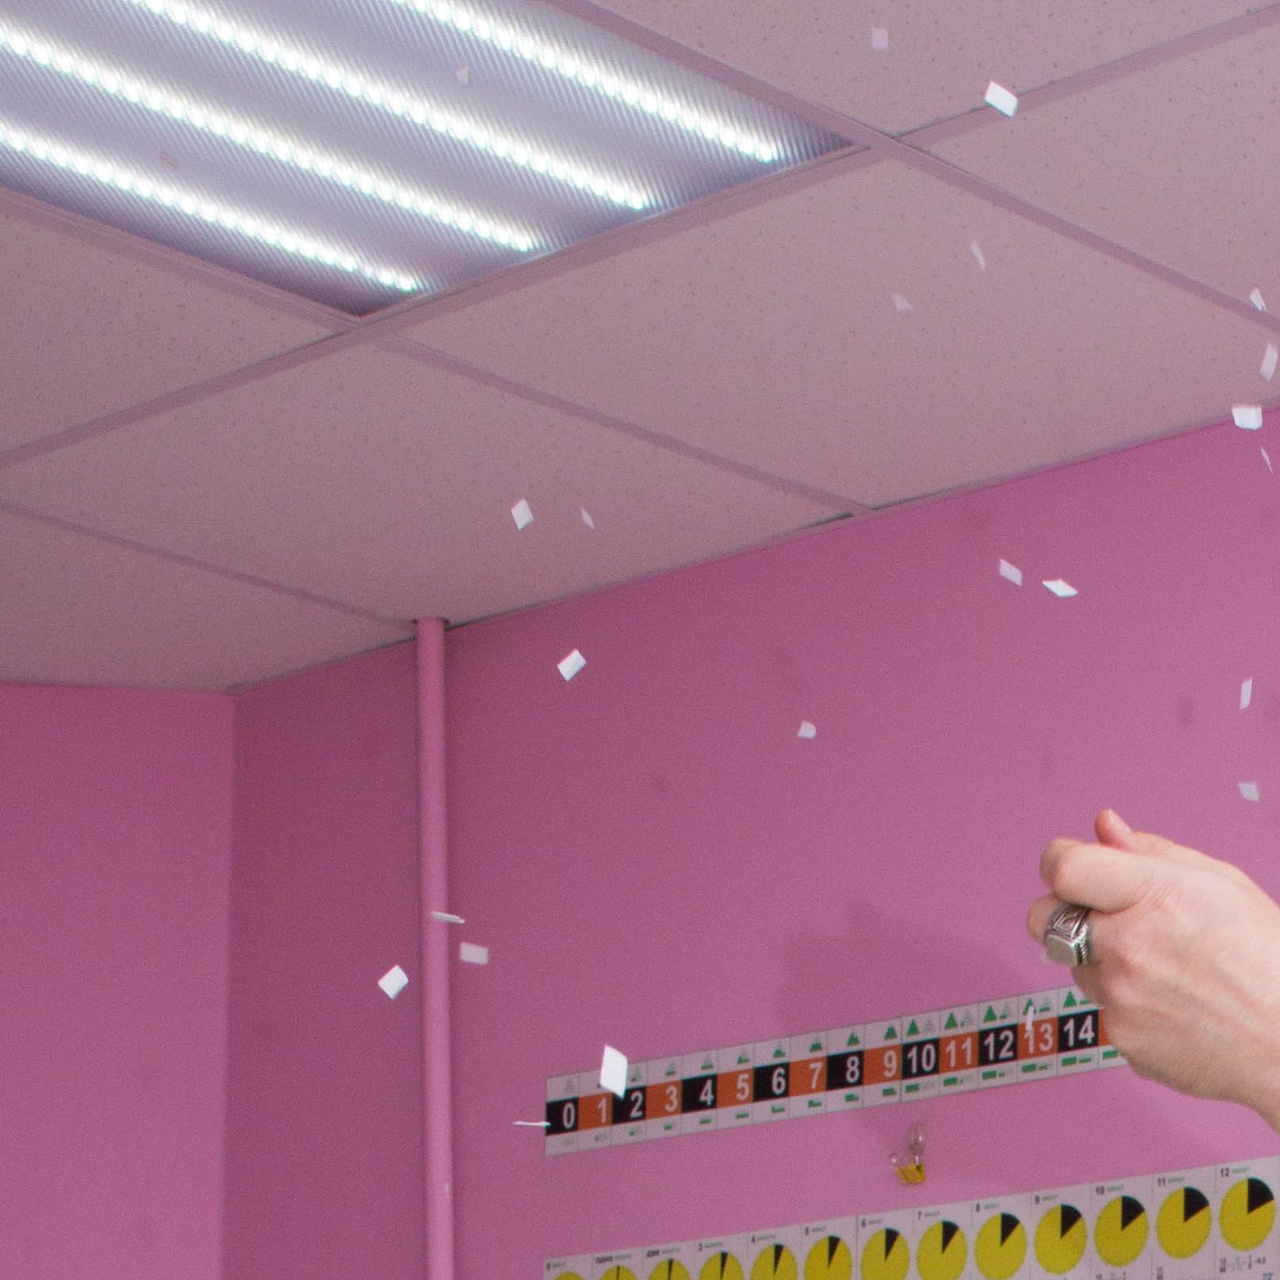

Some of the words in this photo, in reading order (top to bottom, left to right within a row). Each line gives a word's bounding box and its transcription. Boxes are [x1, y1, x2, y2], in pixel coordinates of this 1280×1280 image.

[563, 1103, 575, 1129] 0
[598, 1099, 607, 1124] 1
[630, 1091, 643, 1118] 2
[665, 1086, 677, 1111] 3
[699, 1080, 714, 1105] 4
[736, 1074, 750, 1100] 5
[772, 1068, 786, 1094] 6
[810, 1062, 822, 1089] 7
[846, 1056, 860, 1083] 8
[883, 1050, 896, 1077] 9
[907, 1044, 935, 1074] 10
[946, 1038, 972, 1067] 11
[984, 1031, 1014, 1060] 12
[1024, 1024, 1053, 1054] 13
[1064, 1016, 1094, 1047] 14
[1220, 1168, 1229, 1177] 12
[1158, 1178, 1166, 1186] 11
[1096, 1186, 1105, 1195] 10
[1035, 1195, 1039, 1204] 9
